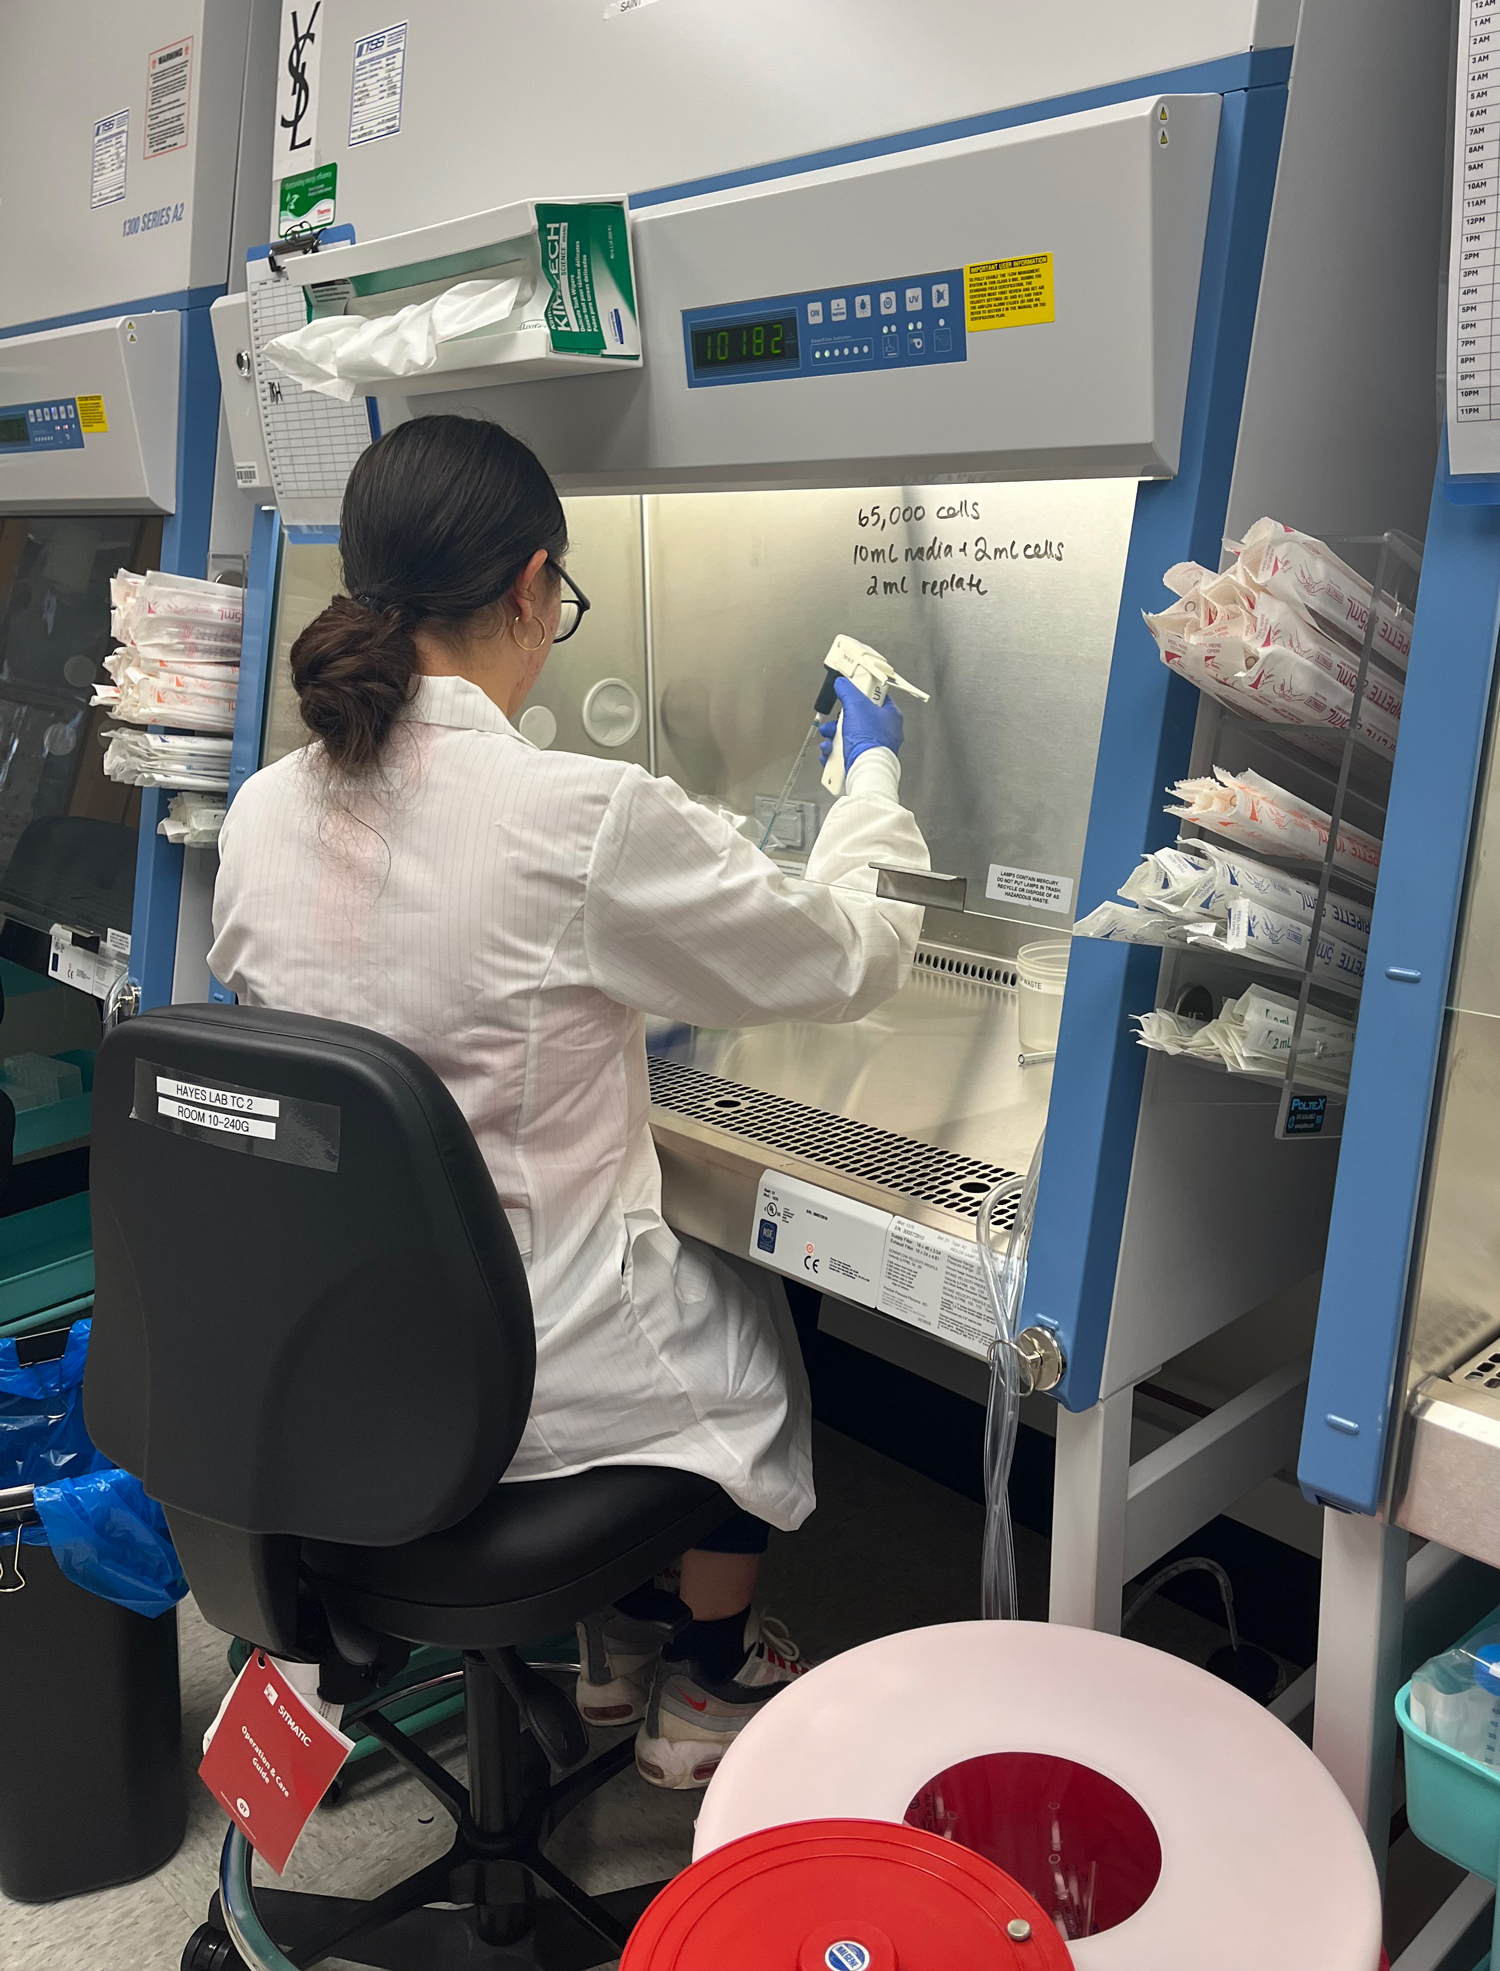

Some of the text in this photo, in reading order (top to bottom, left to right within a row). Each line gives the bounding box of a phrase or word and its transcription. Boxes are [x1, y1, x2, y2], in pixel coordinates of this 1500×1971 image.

[1480, 18, 1490, 26] AM
[1478, 35, 1490, 44] AM
[1478, 54, 1489, 62] AM
[1477, 72, 1488, 81] AM
[1476, 90, 1488, 99] AM
[1475, 108, 1486, 117] AM
[1469, 127, 1484, 136] 7AM
[1468, 145, 1484, 154] 8AM
[1468, 163, 1483, 171] 9AM
[1468, 181, 1486, 190] 10AM
[1467, 199, 1486, 208] 11AM
[122, 202, 185, 238] 1300 SERIES A2
[1466, 216, 1485, 225] 12PM
[1464, 252, 1479, 260] 2PM
[970, 256, 1047, 274] IMPORTANT USER INFORMATION
[570, 274, 580, 297] Wipers
[573, 296, 582, 310] Task
[908, 295, 920, 304] UV
[810, 309, 820, 318] ON
[858, 500, 980, 531] 65,000 cells
[1023, 540, 1064, 562] cells
[922, 574, 988, 598] replate
[873, 686, 882, 701] UP
[997, 883, 1018, 892] RECYCLE
[1026, 889, 1045, 897] DISPOSE
[1005, 892, 1031, 900] HAZARDOUS
[1024, 979, 1041, 989] WASTE
[1272, 1037, 1291, 1049] 2 mL
[176, 1083, 253, 1111] HAYES LAB TC 2
[177, 1105, 205, 1124] ROOM
[804, 1256, 820, 1274] CE
[277, 1704, 312, 1747] SITMATIC
[241, 1725, 290, 1798] Operation & Care
[252, 1757, 270, 1785] Guide
